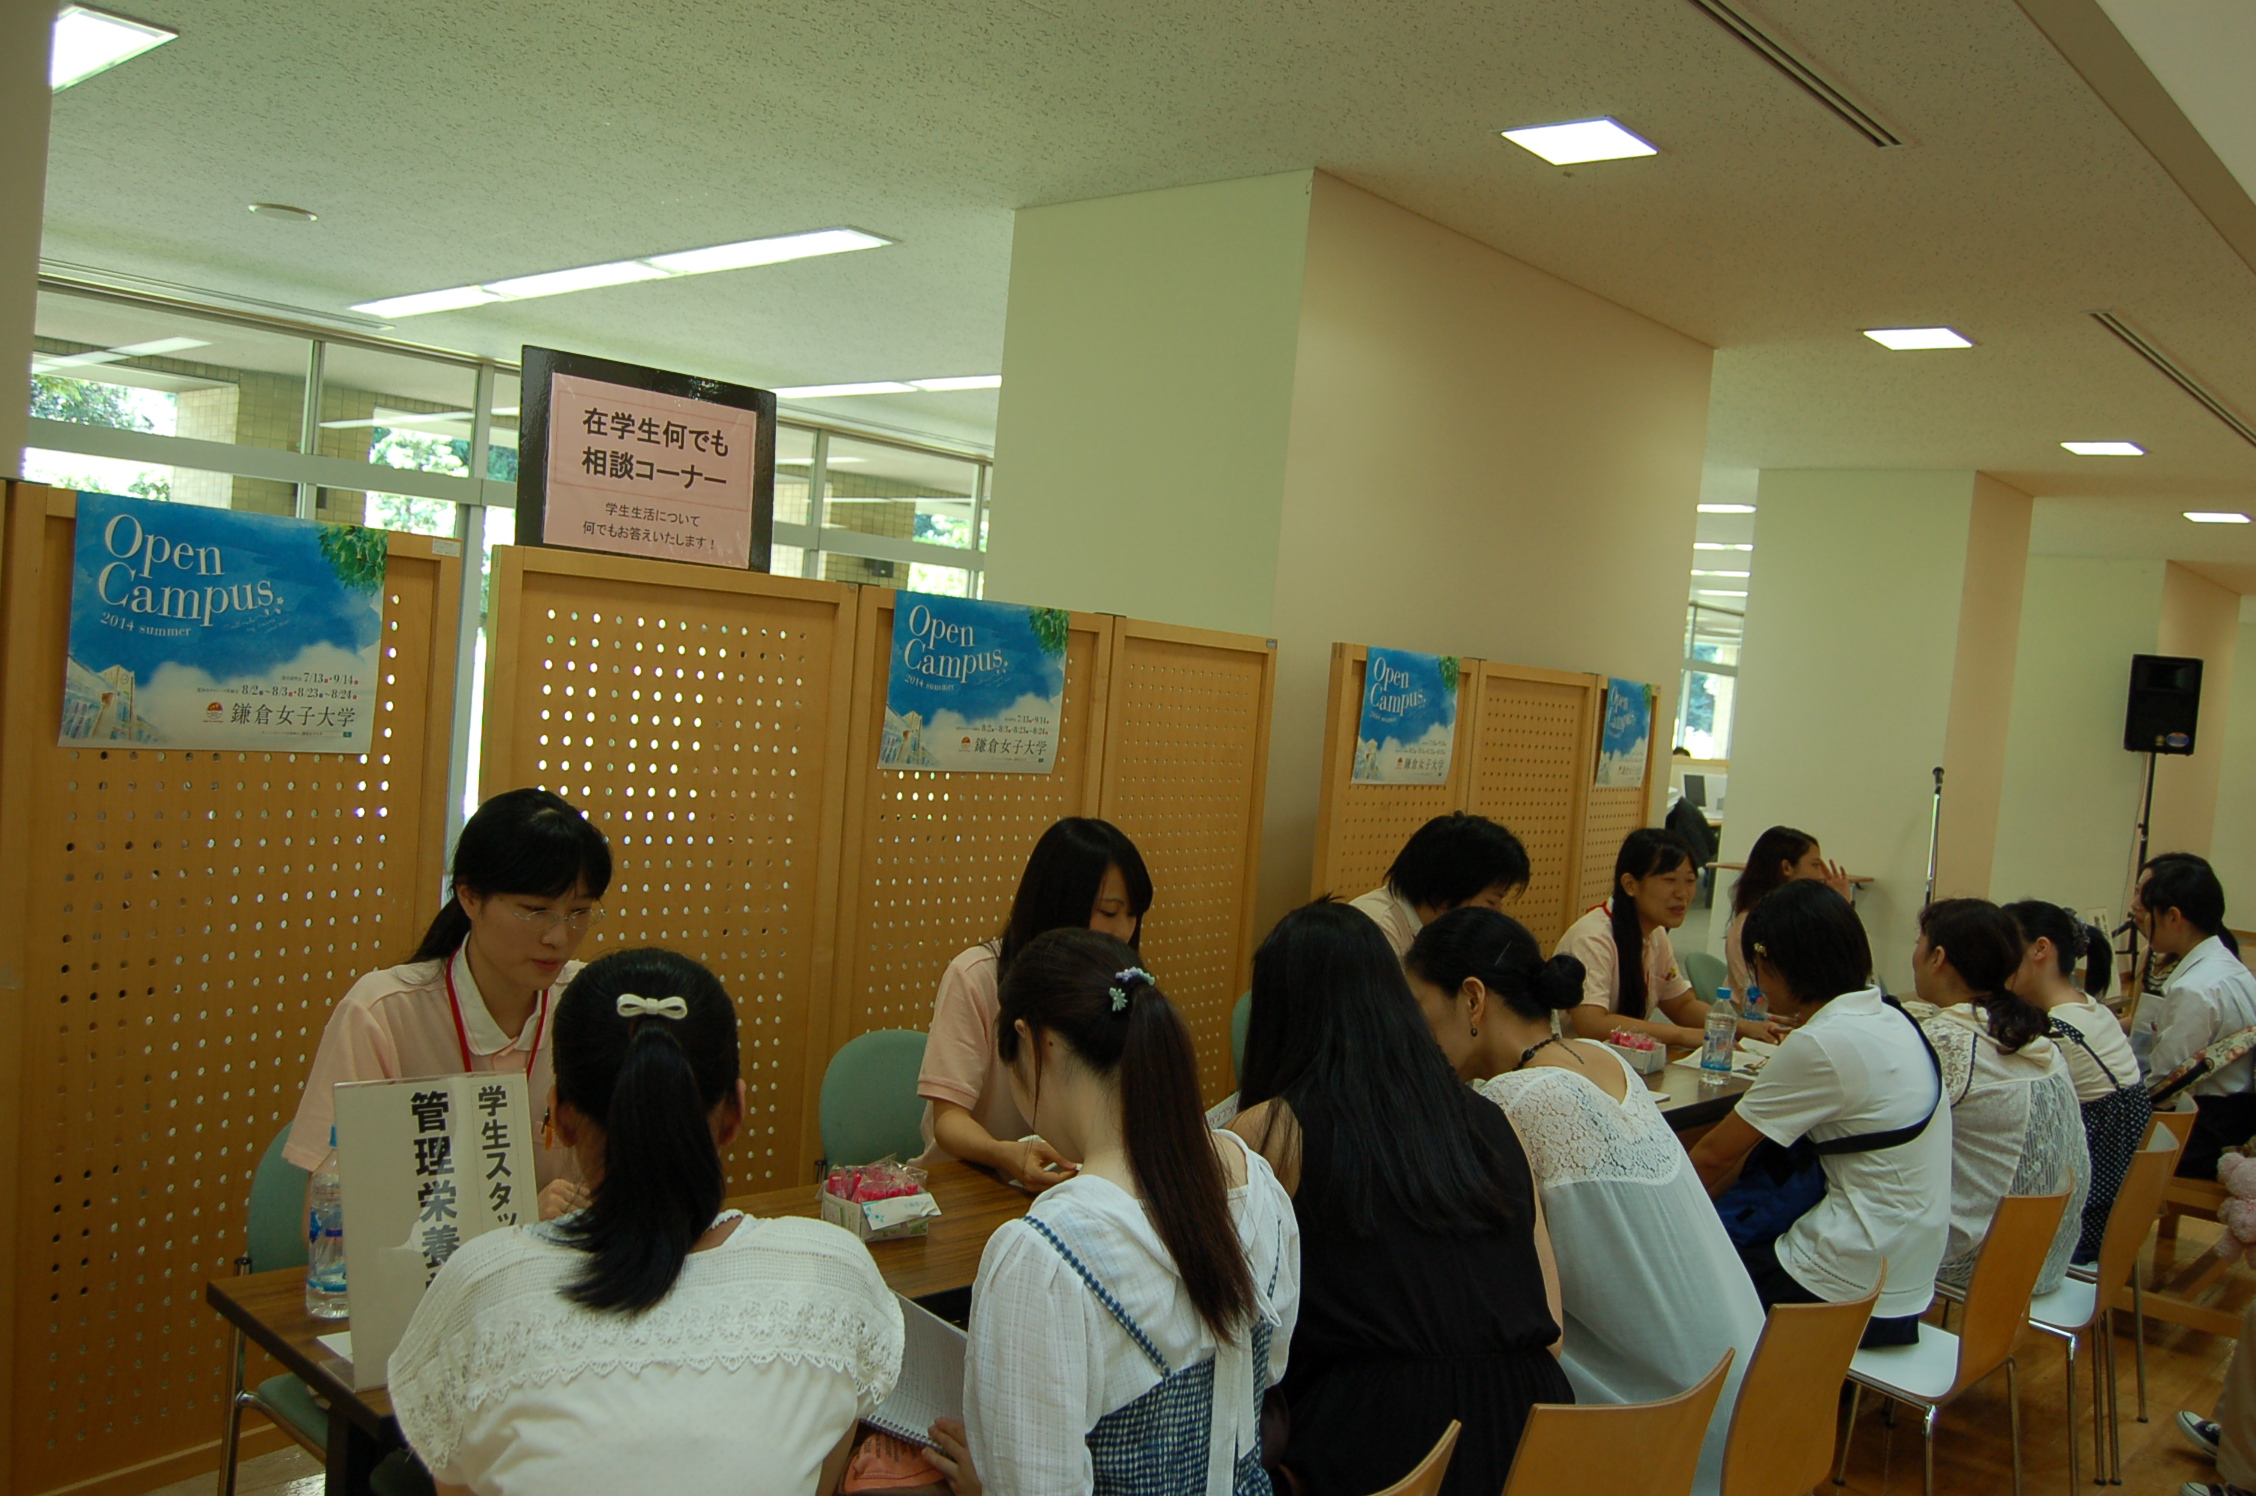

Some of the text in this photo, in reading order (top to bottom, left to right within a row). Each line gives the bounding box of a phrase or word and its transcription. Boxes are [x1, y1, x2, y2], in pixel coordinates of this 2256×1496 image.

[582, 407, 729, 457] 在学生何でも
[581, 446, 727, 489] 相談コーナー
[605, 502, 701, 527] 学生生活について
[104, 513, 225, 579] Open
[99, 611, 191, 637] 2014 summer
[908, 604, 975, 650] Open
[904, 674, 924, 688] 2014
[1373, 656, 1409, 692] Open
[230, 702, 356, 727] 鎌倉女子大学
[974, 737, 1048, 755] 鎌倉女子大学
[410, 1090, 461, 1289] 管理栄養
